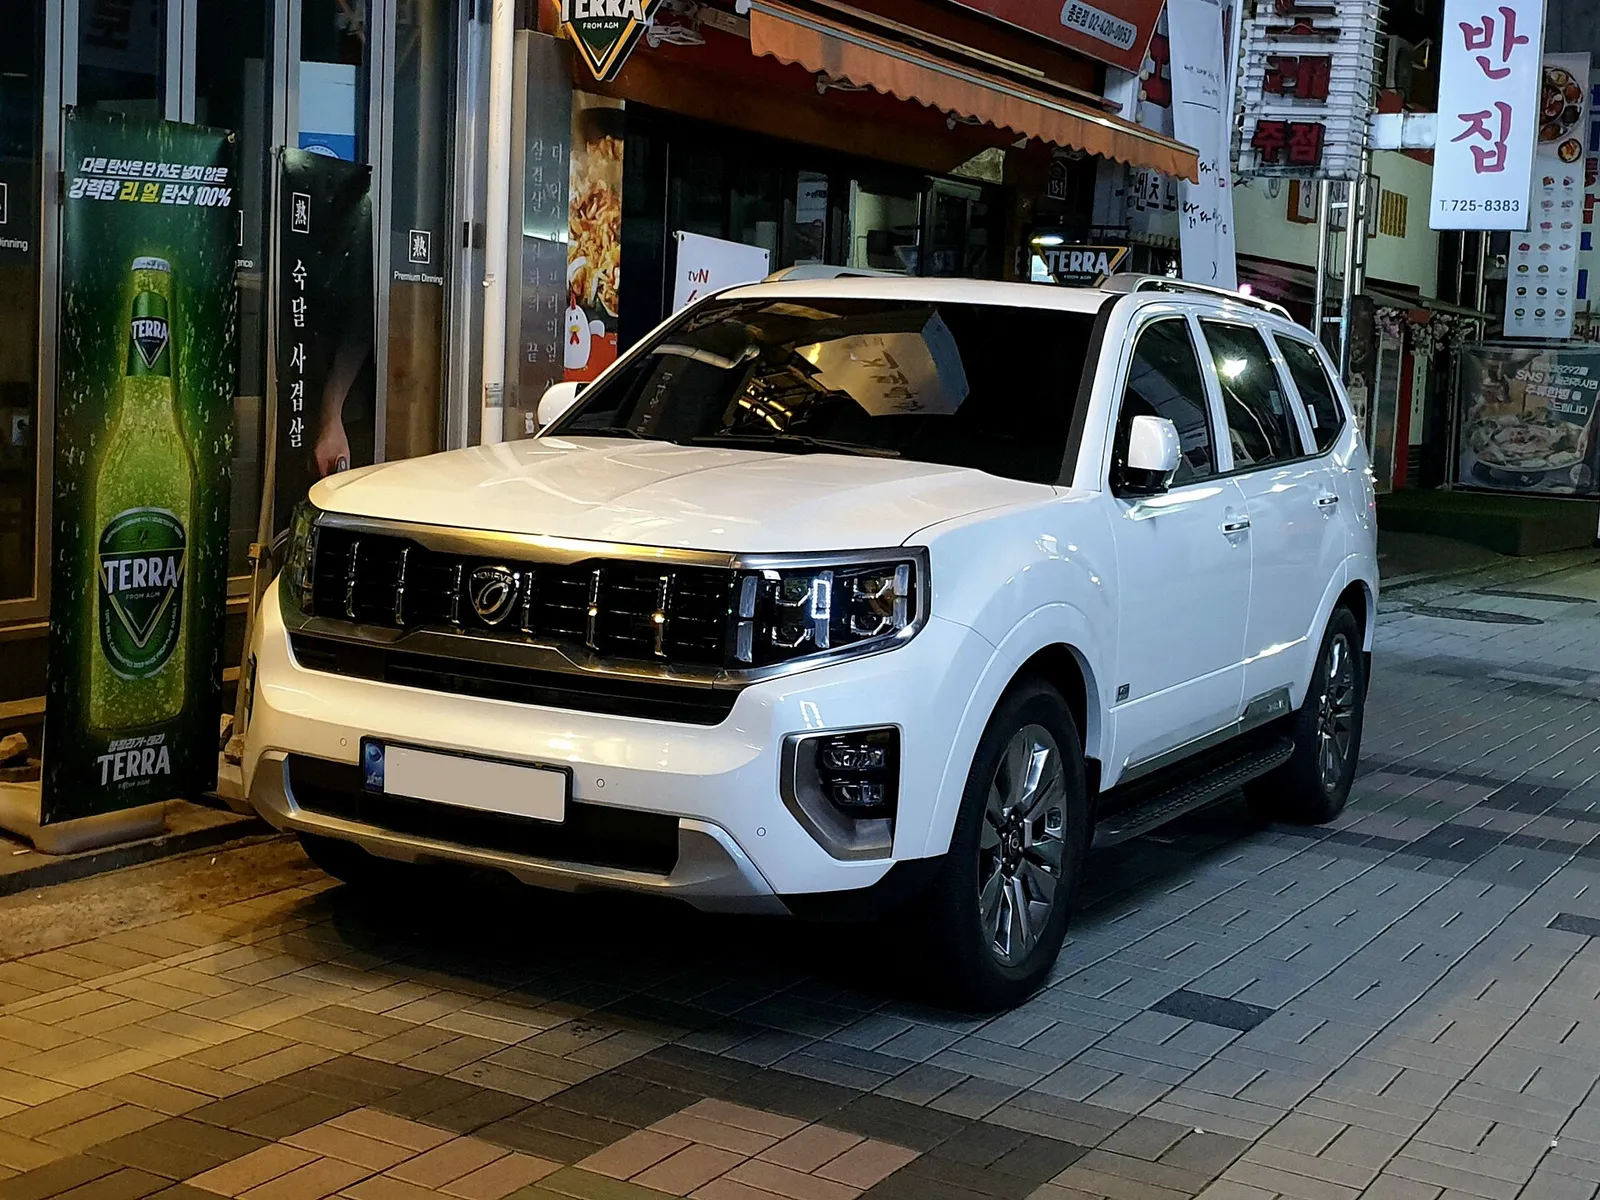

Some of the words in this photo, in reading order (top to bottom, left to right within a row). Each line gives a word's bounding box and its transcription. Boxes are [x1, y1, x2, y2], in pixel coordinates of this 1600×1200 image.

[81, 158, 107, 173] 다른
[106, 159, 142, 176] 탄산은
[143, 162, 156, 177] 단
[69, 178, 120, 200] 강력한
[193, 187, 232, 207] 100%
[1451, 199, 1520, 212] 725-8383
[1044, 250, 1109, 276] TERRA
[394, 270, 420, 281] Premium
[688, 268, 709, 284] tvN
[131, 320, 169, 342] TERRA
[104, 556, 178, 594] TERRA
[97, 745, 171, 786] TERRA
